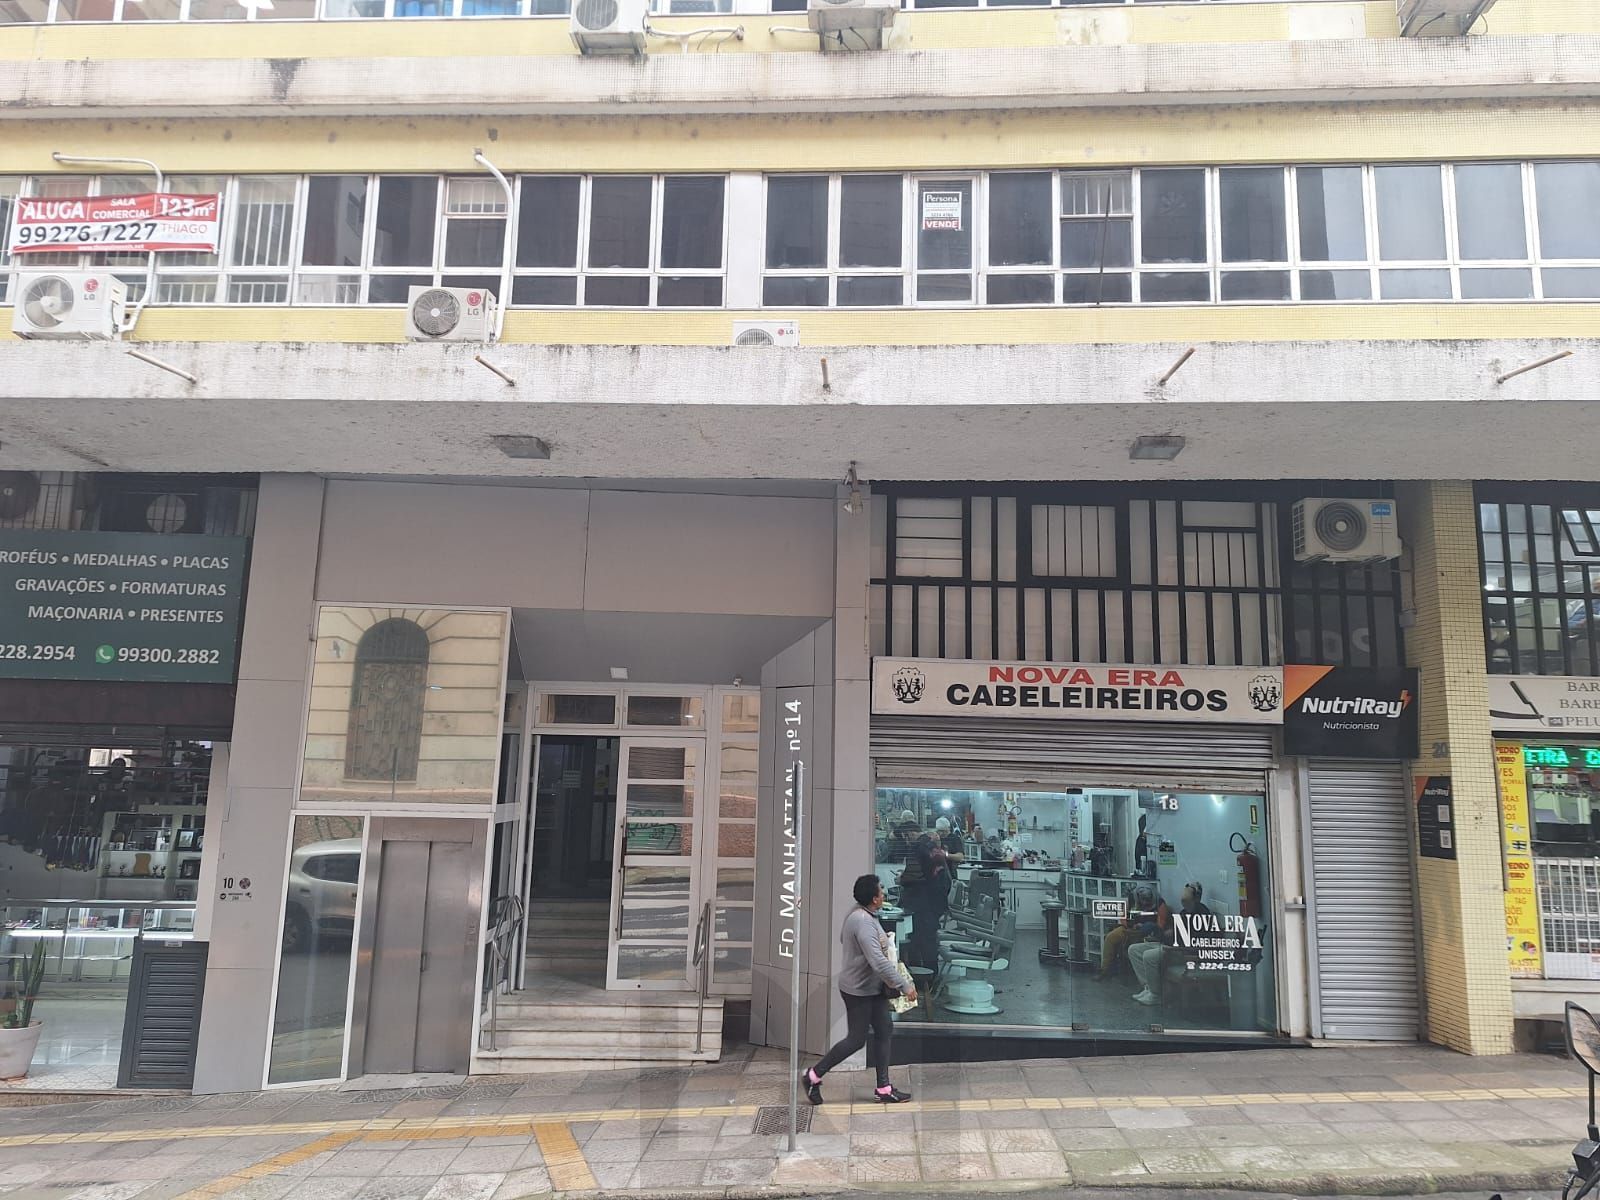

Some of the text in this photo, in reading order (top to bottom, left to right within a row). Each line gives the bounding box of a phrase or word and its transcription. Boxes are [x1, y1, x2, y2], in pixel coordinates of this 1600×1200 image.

[111, 198, 136, 206] SALA
[22, 201, 84, 220] ALUGA
[93, 209, 150, 219] COMERCIAL
[926, 220, 958, 228] VENDE
[20, 222, 157, 243] 99276.7227
[467, 308, 479, 316] LG
[0, 549, 229, 569] ROFÉUS MEDALHAS PLACAS
[15, 577, 226, 596] GRAVAÇÕES FORMATURAS
[28, 606, 224, 623] MAÇONARIA PRESENTES
[118, 647, 219, 664] 99300.2882
[989, 666, 1184, 687] NOVA ERA
[946, 683, 1228, 711] CABELEIREIROS
[1302, 697, 1403, 718] NutriRay
[1323, 721, 1380, 730] Nutricionista
[1159, 795, 1178, 810] 18
[223, 878, 233, 888] 10
[1096, 903, 1123, 911] ENTRE
[1172, 914, 1263, 948] NOVA ERA
[1191, 937, 1241, 948] CABELEIREIROS
[1198, 950, 1235, 960] UNISSEX
[1199, 962, 1252, 971] 3224-6255
